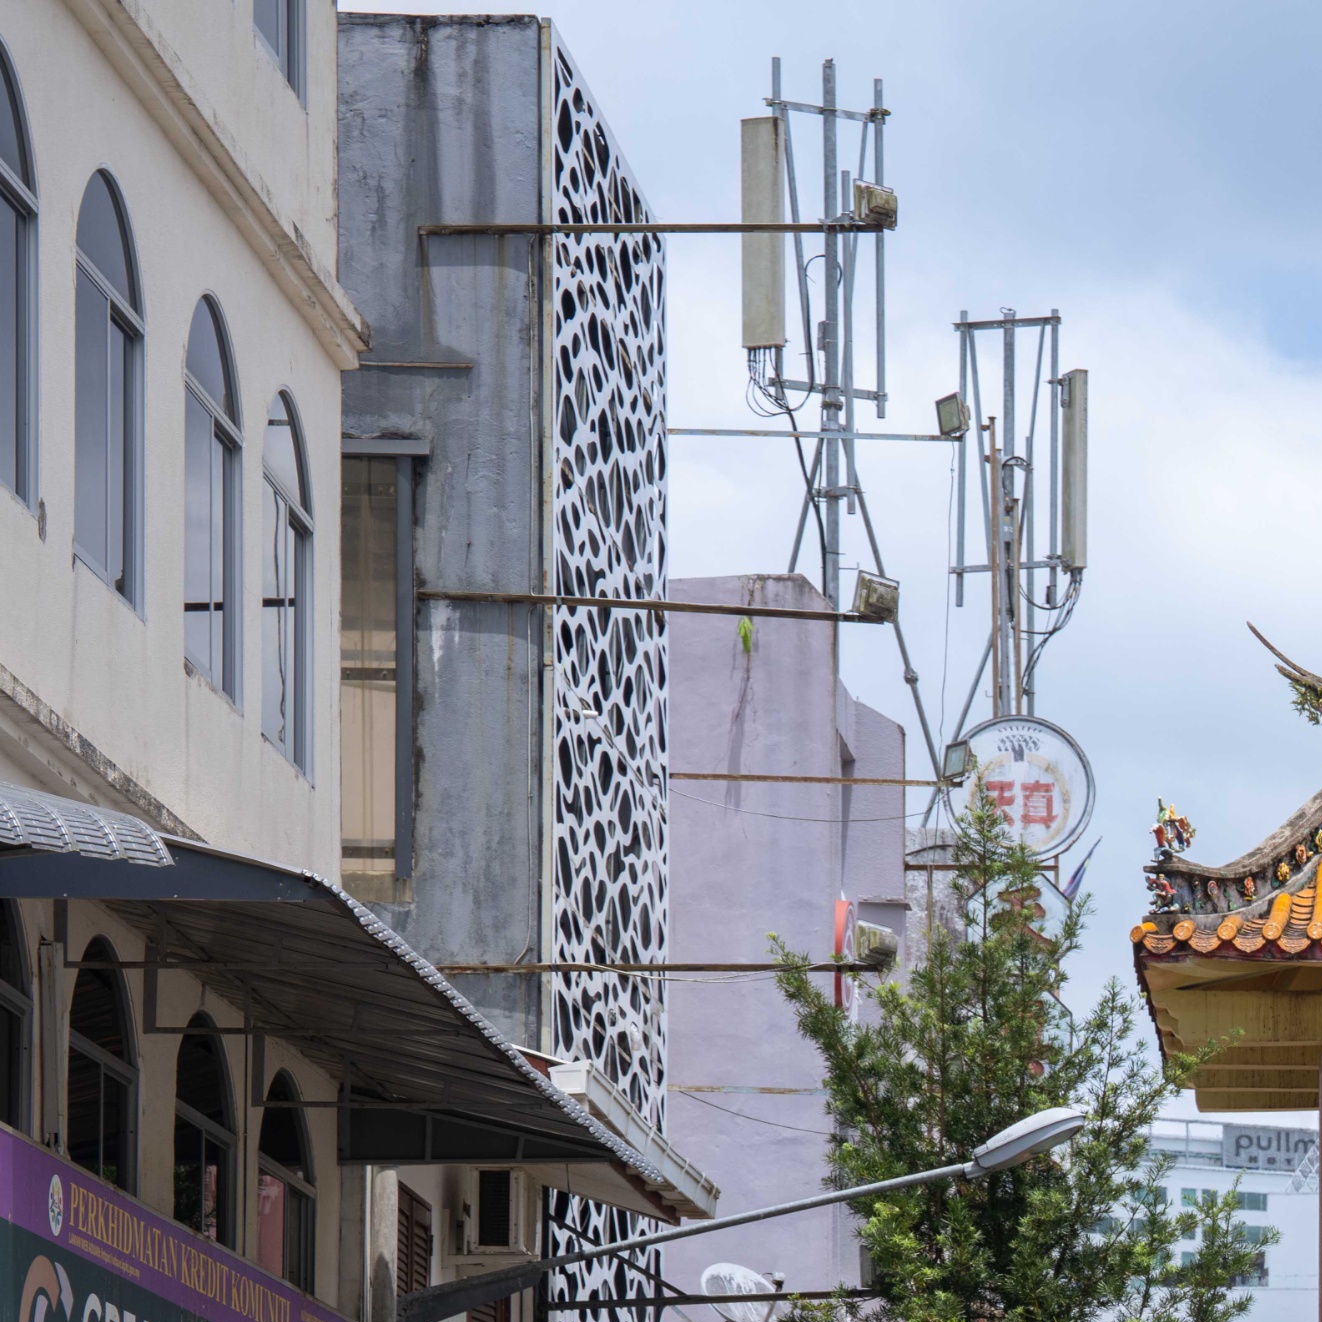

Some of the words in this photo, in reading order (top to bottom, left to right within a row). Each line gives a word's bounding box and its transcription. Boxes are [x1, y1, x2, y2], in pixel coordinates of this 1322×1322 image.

[1235, 1131, 1316, 1157] pullm
[1248, 1155, 1294, 1166] HOT
[69, 1182, 178, 1280] PERKHIDMATAN
[181, 1243, 229, 1306] KREDIT
